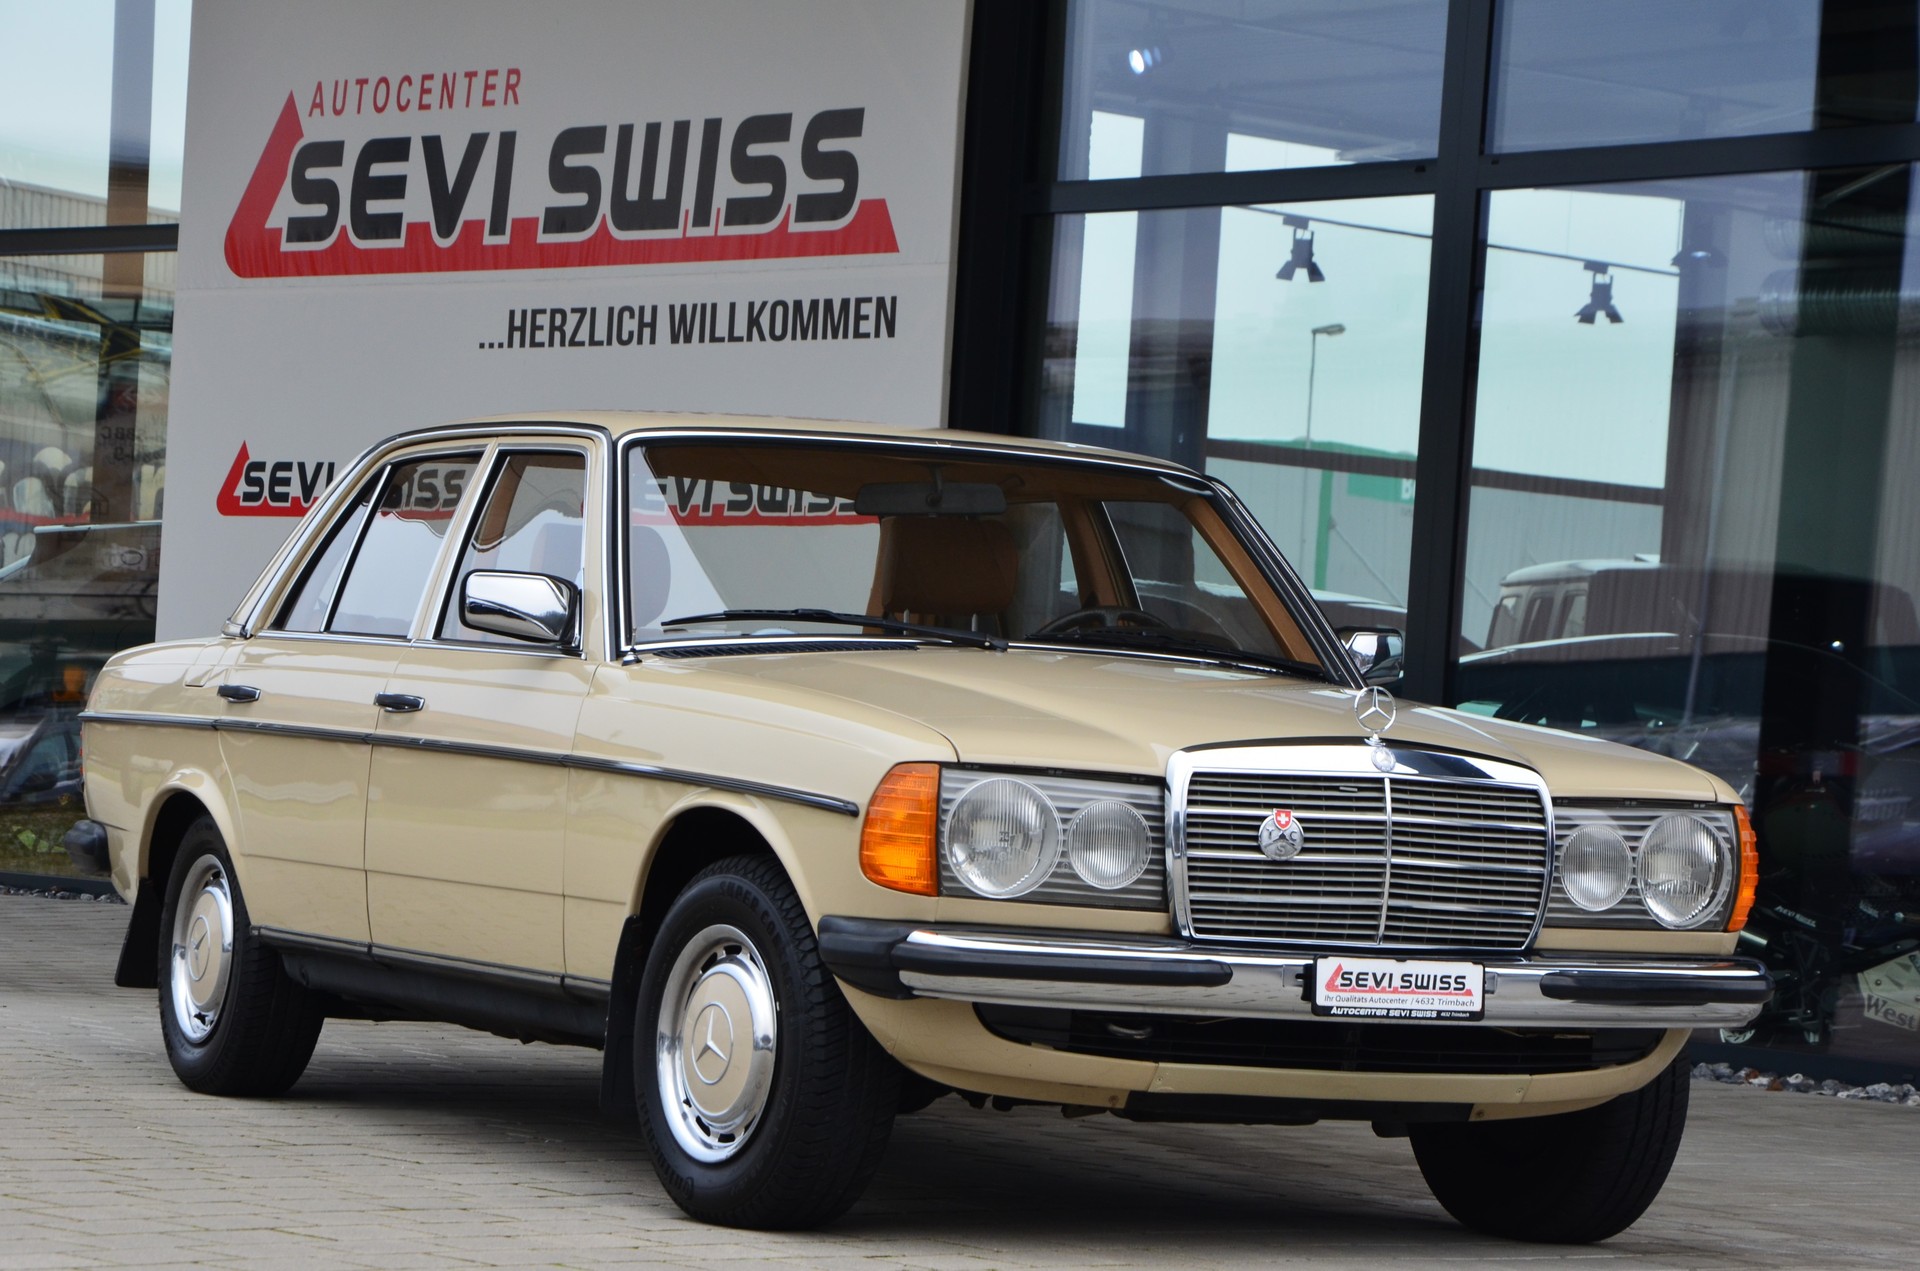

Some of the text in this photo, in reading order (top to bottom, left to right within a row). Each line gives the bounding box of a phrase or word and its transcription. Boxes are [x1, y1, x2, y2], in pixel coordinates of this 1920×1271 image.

[308, 68, 521, 117] AUTOCENTER
[285, 107, 865, 245] SEVI SWISS
[669, 296, 898, 345] WILLKOMMEN
[1340, 971, 1467, 992] SEVI SWISS
[1324, 994, 1334, 1002] Ihr
[1368, 996, 1408, 1005] Autocenter
[1415, 997, 1435, 1006] 4632
[1438, 998, 1475, 1008] Trimbach
[1330, 1006, 1388, 1016] AUTOCENTER
[1389, 1009, 1410, 1017] SEVI
[1410, 1009, 1438, 1018] SWISS
[1866, 993, 1915, 1030] West
